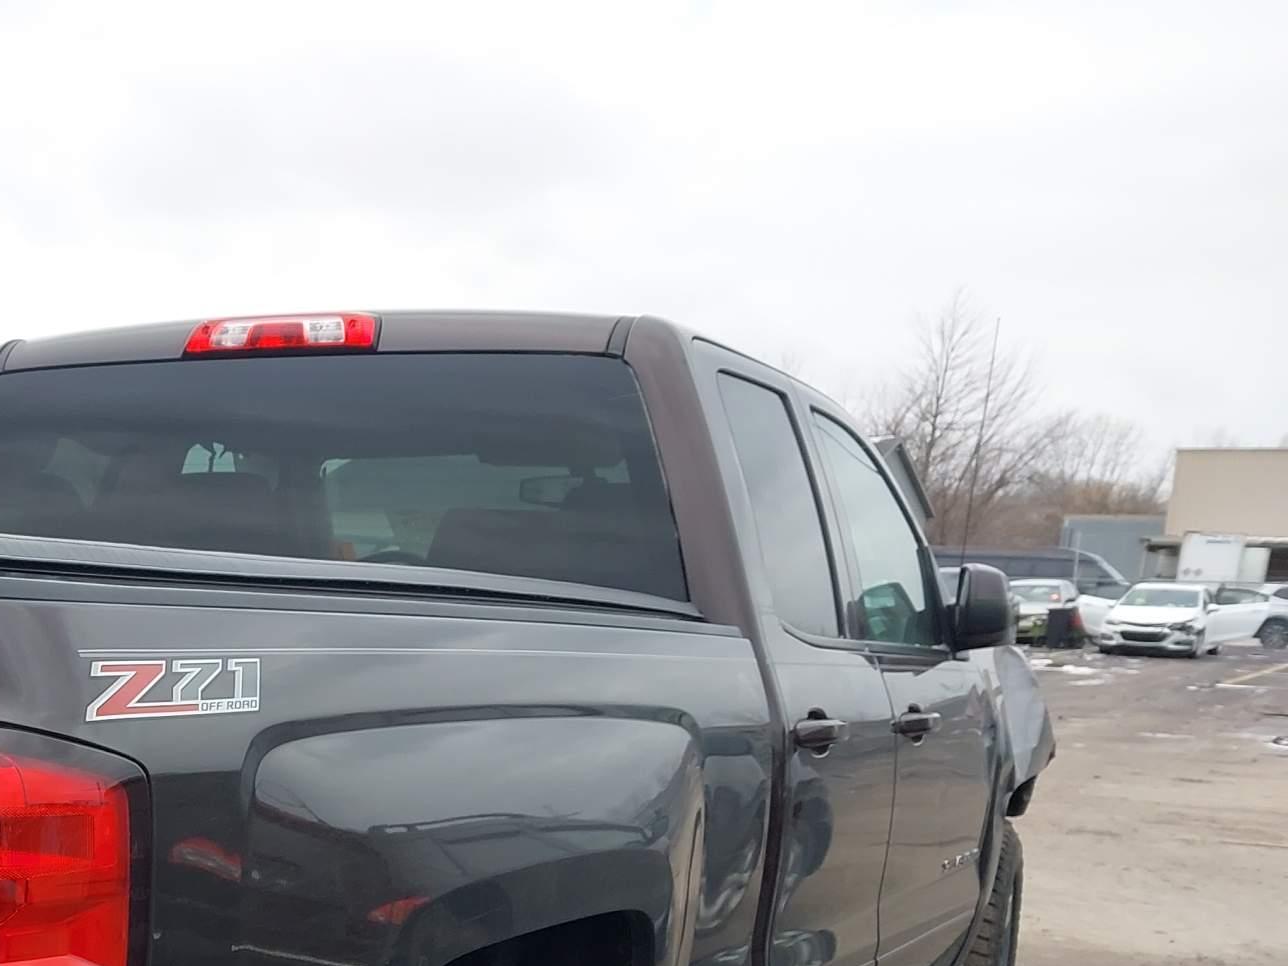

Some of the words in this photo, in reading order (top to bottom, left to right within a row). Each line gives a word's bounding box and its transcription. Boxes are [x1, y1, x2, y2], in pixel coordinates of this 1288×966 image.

[86, 658, 260, 722] Z71
[201, 702, 223, 712] OFF
[226, 699, 258, 710] ROAD
